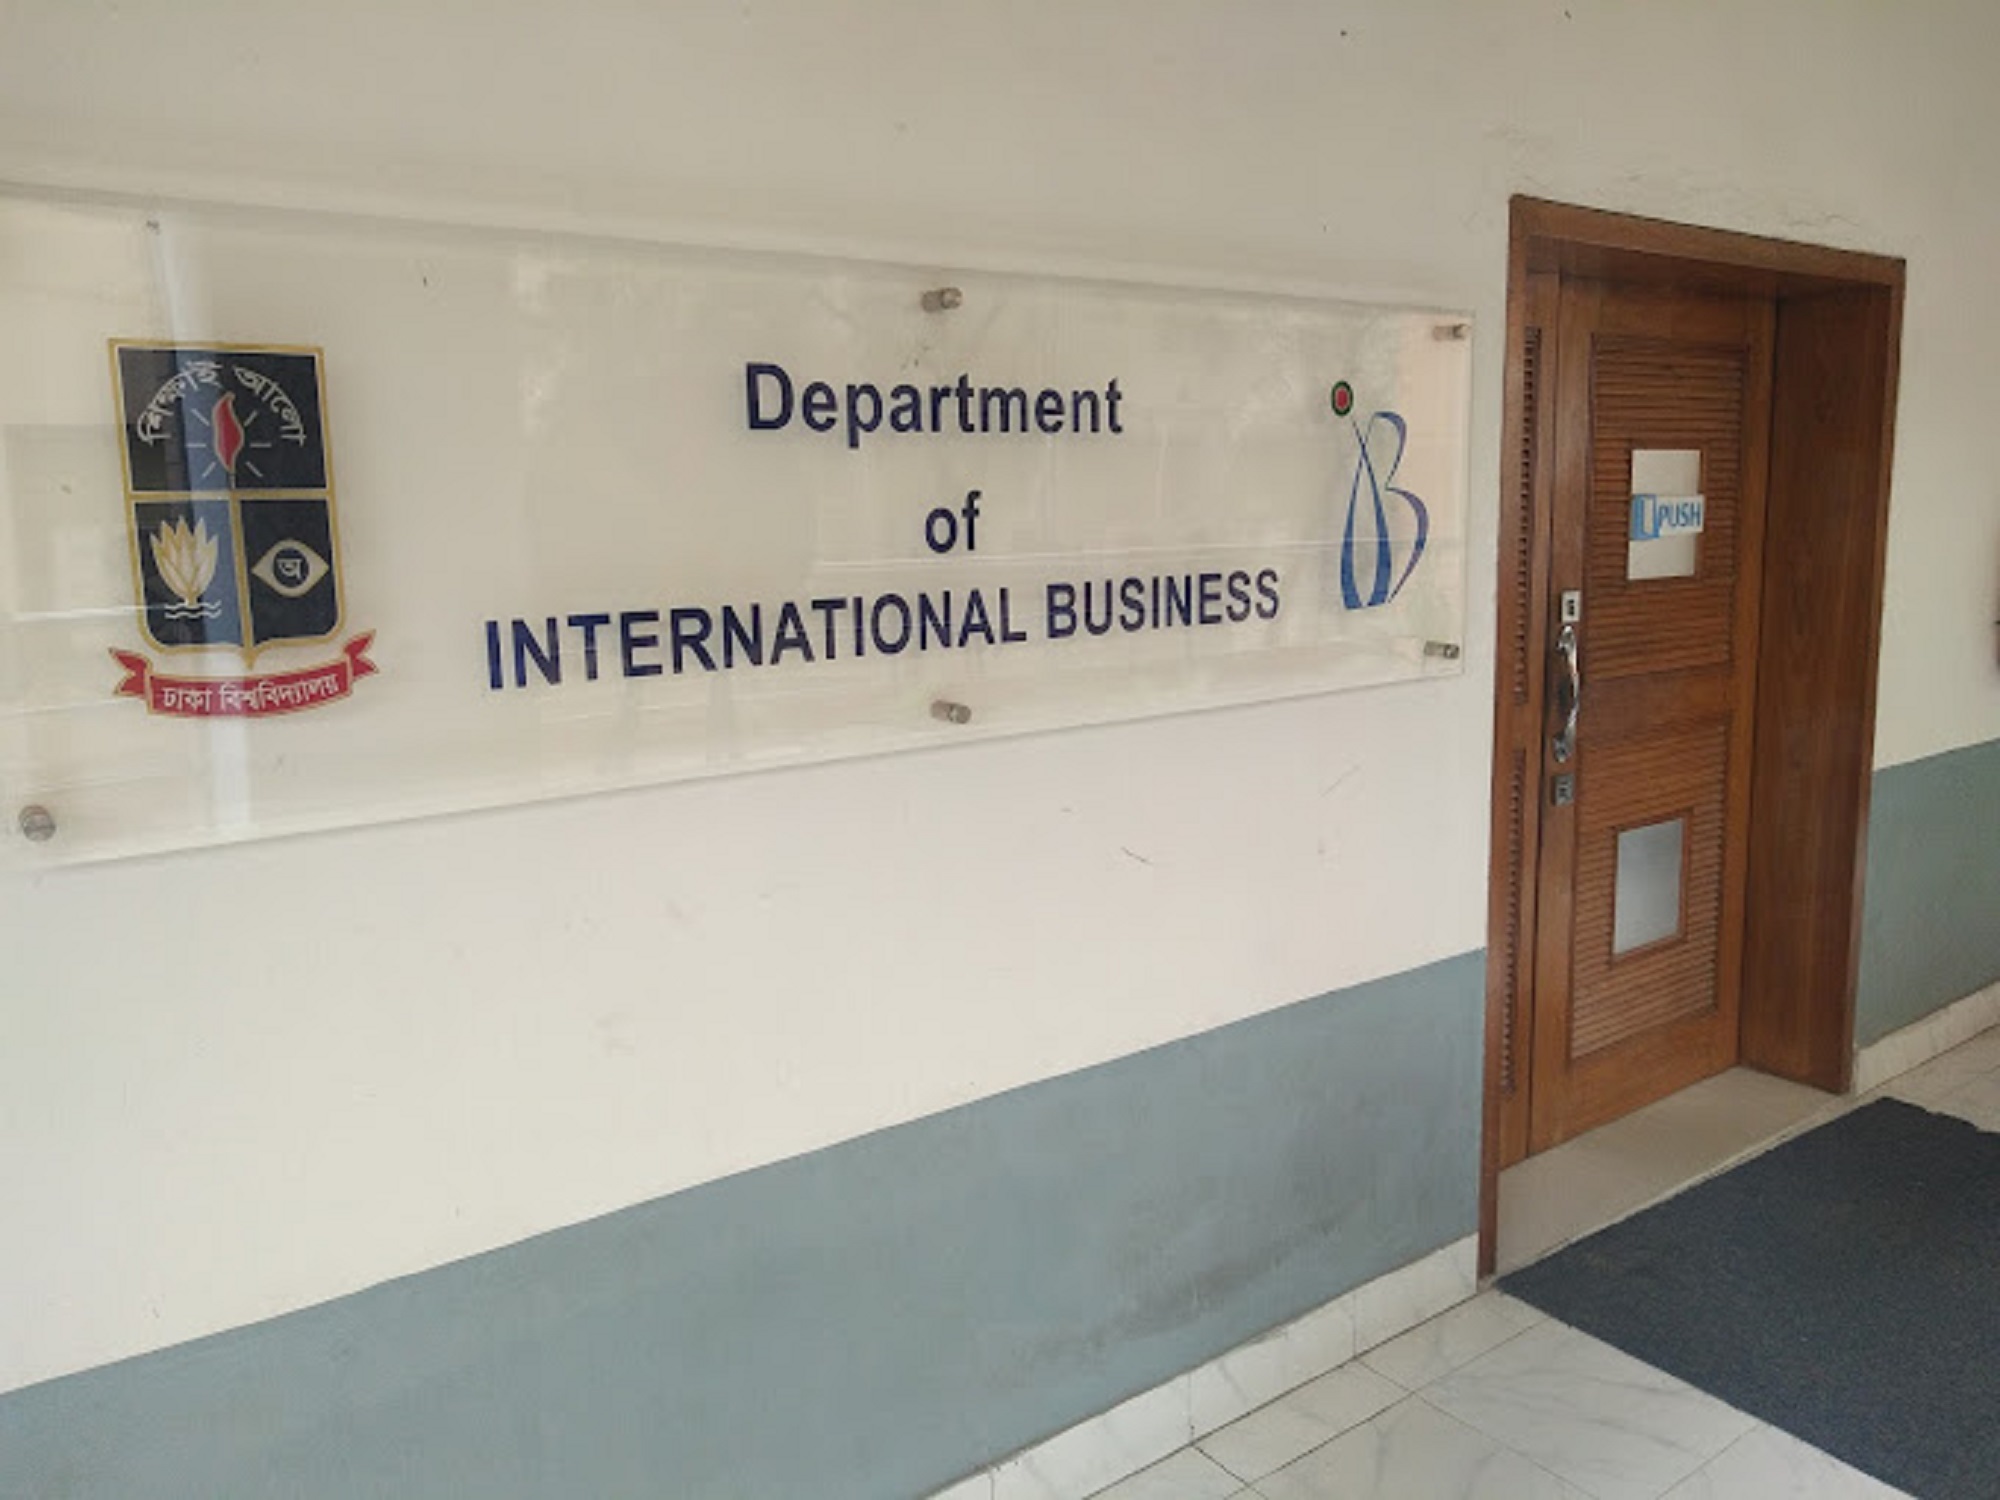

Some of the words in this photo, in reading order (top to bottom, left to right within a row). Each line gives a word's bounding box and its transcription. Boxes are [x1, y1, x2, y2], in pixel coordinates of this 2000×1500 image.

[745, 362, 1123, 450] Department
[925, 489, 982, 555] of
[1658, 501, 1702, 528] PUSH
[485, 587, 1028, 690] INTERNATIONAL
[1045, 569, 1280, 640] BUSINESS
[163, 685, 212, 712] ঢাকা
